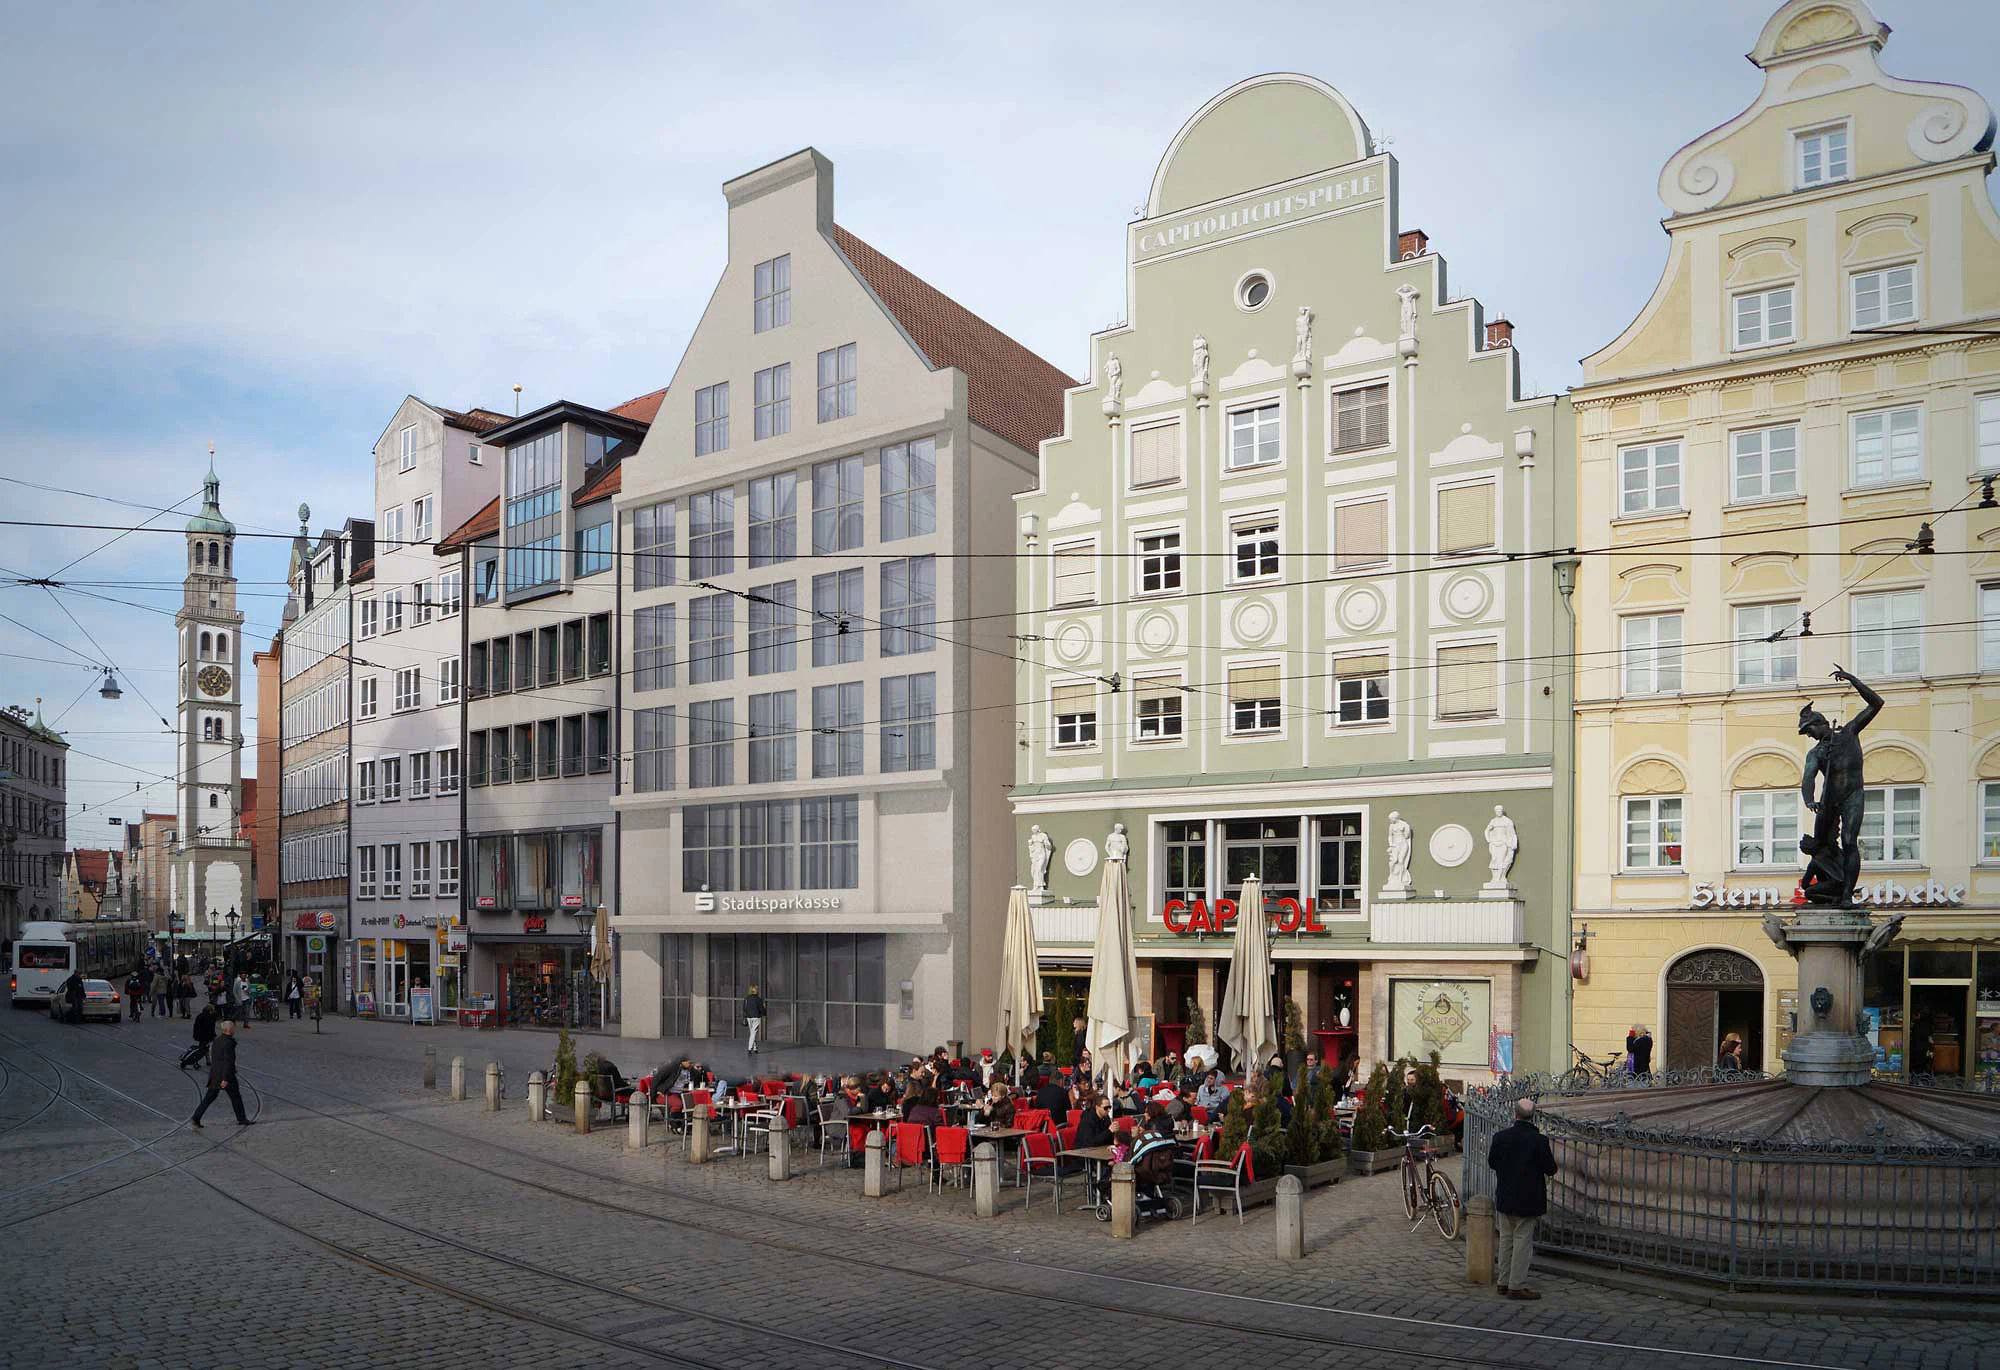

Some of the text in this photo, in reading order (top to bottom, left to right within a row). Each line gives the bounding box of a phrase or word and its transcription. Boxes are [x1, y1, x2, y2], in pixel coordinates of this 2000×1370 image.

[722, 895, 841, 912] Stadtsparkasse
[1691, 881, 1780, 907] Stern
[1163, 897, 1326, 932] CAPOL
[1423, 1016, 1462, 1027] CAPITOL
